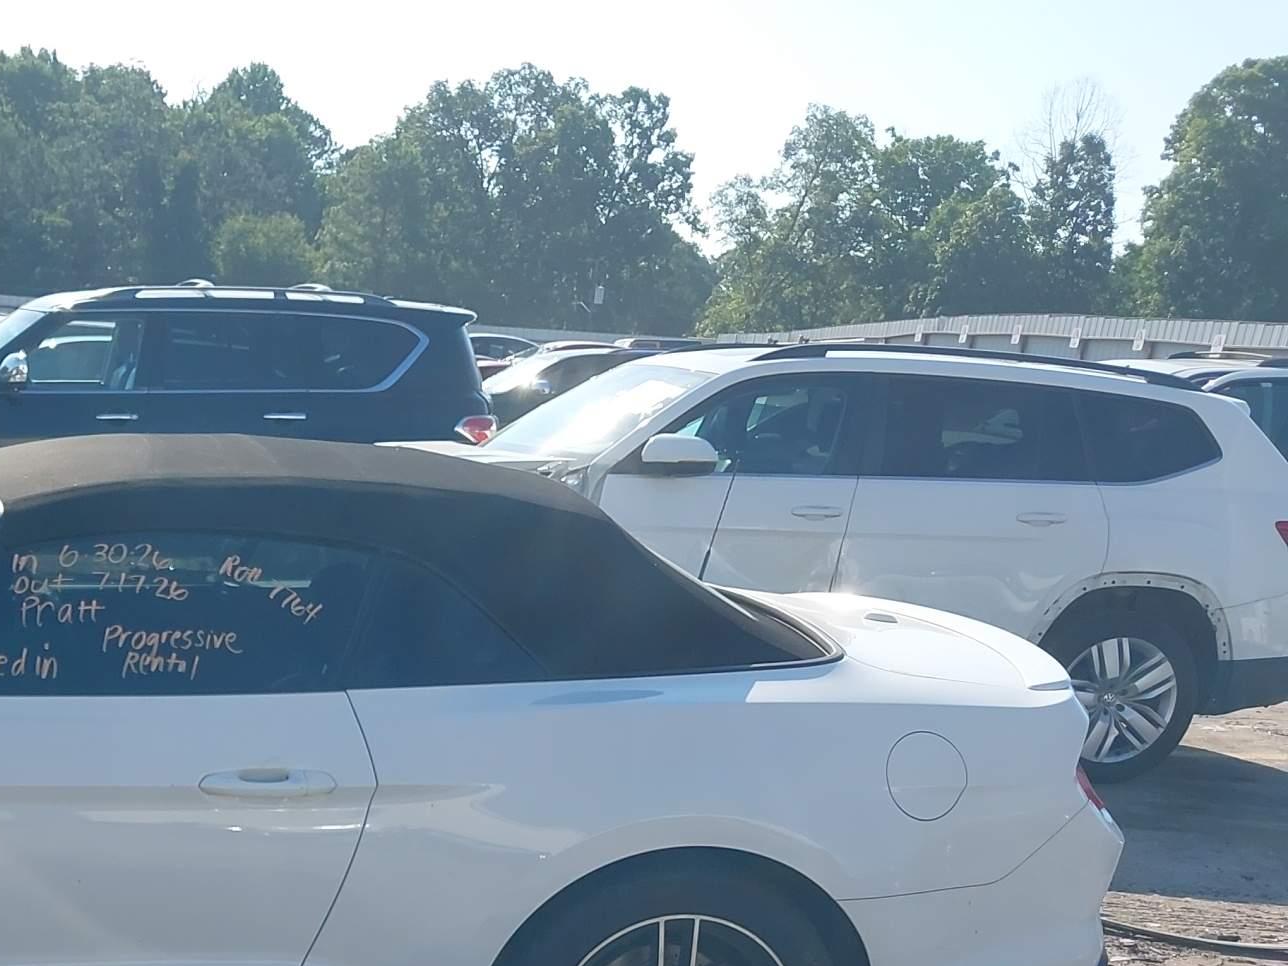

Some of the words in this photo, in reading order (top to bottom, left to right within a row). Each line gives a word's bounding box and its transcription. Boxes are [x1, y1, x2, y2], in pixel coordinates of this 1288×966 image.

[21, 596, 105, 627] Pratt
[102, 624, 244, 656] Progressive
[35, 642, 58, 679] in
[121, 651, 199, 680] Rental
